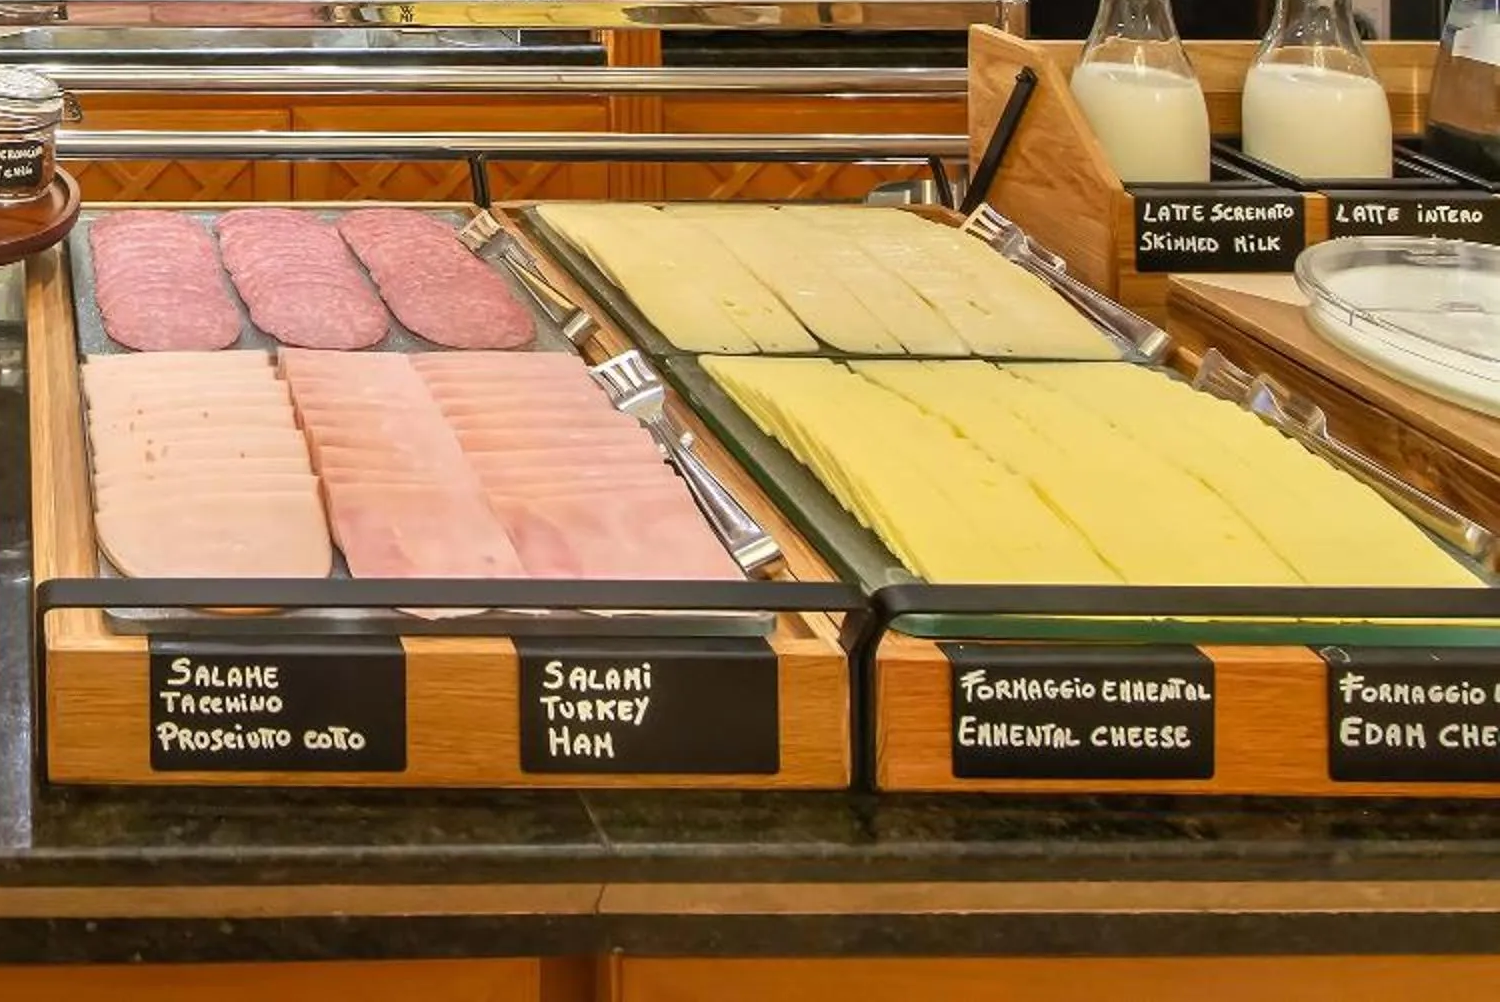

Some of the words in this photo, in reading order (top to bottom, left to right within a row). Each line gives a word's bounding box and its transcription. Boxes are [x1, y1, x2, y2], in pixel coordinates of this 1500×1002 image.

[1143, 202, 1205, 223] LATTE
[1335, 203, 1400, 226] LATTE
[166, 656, 280, 689] SALAME
[539, 695, 650, 726] TURKEY
[302, 725, 367, 751] COTTO
[547, 725, 615, 759] HAM
[1089, 724, 1192, 749] CHEESE
[1339, 715, 1427, 749] EDAM
[1437, 722, 1500, 749] CHE
